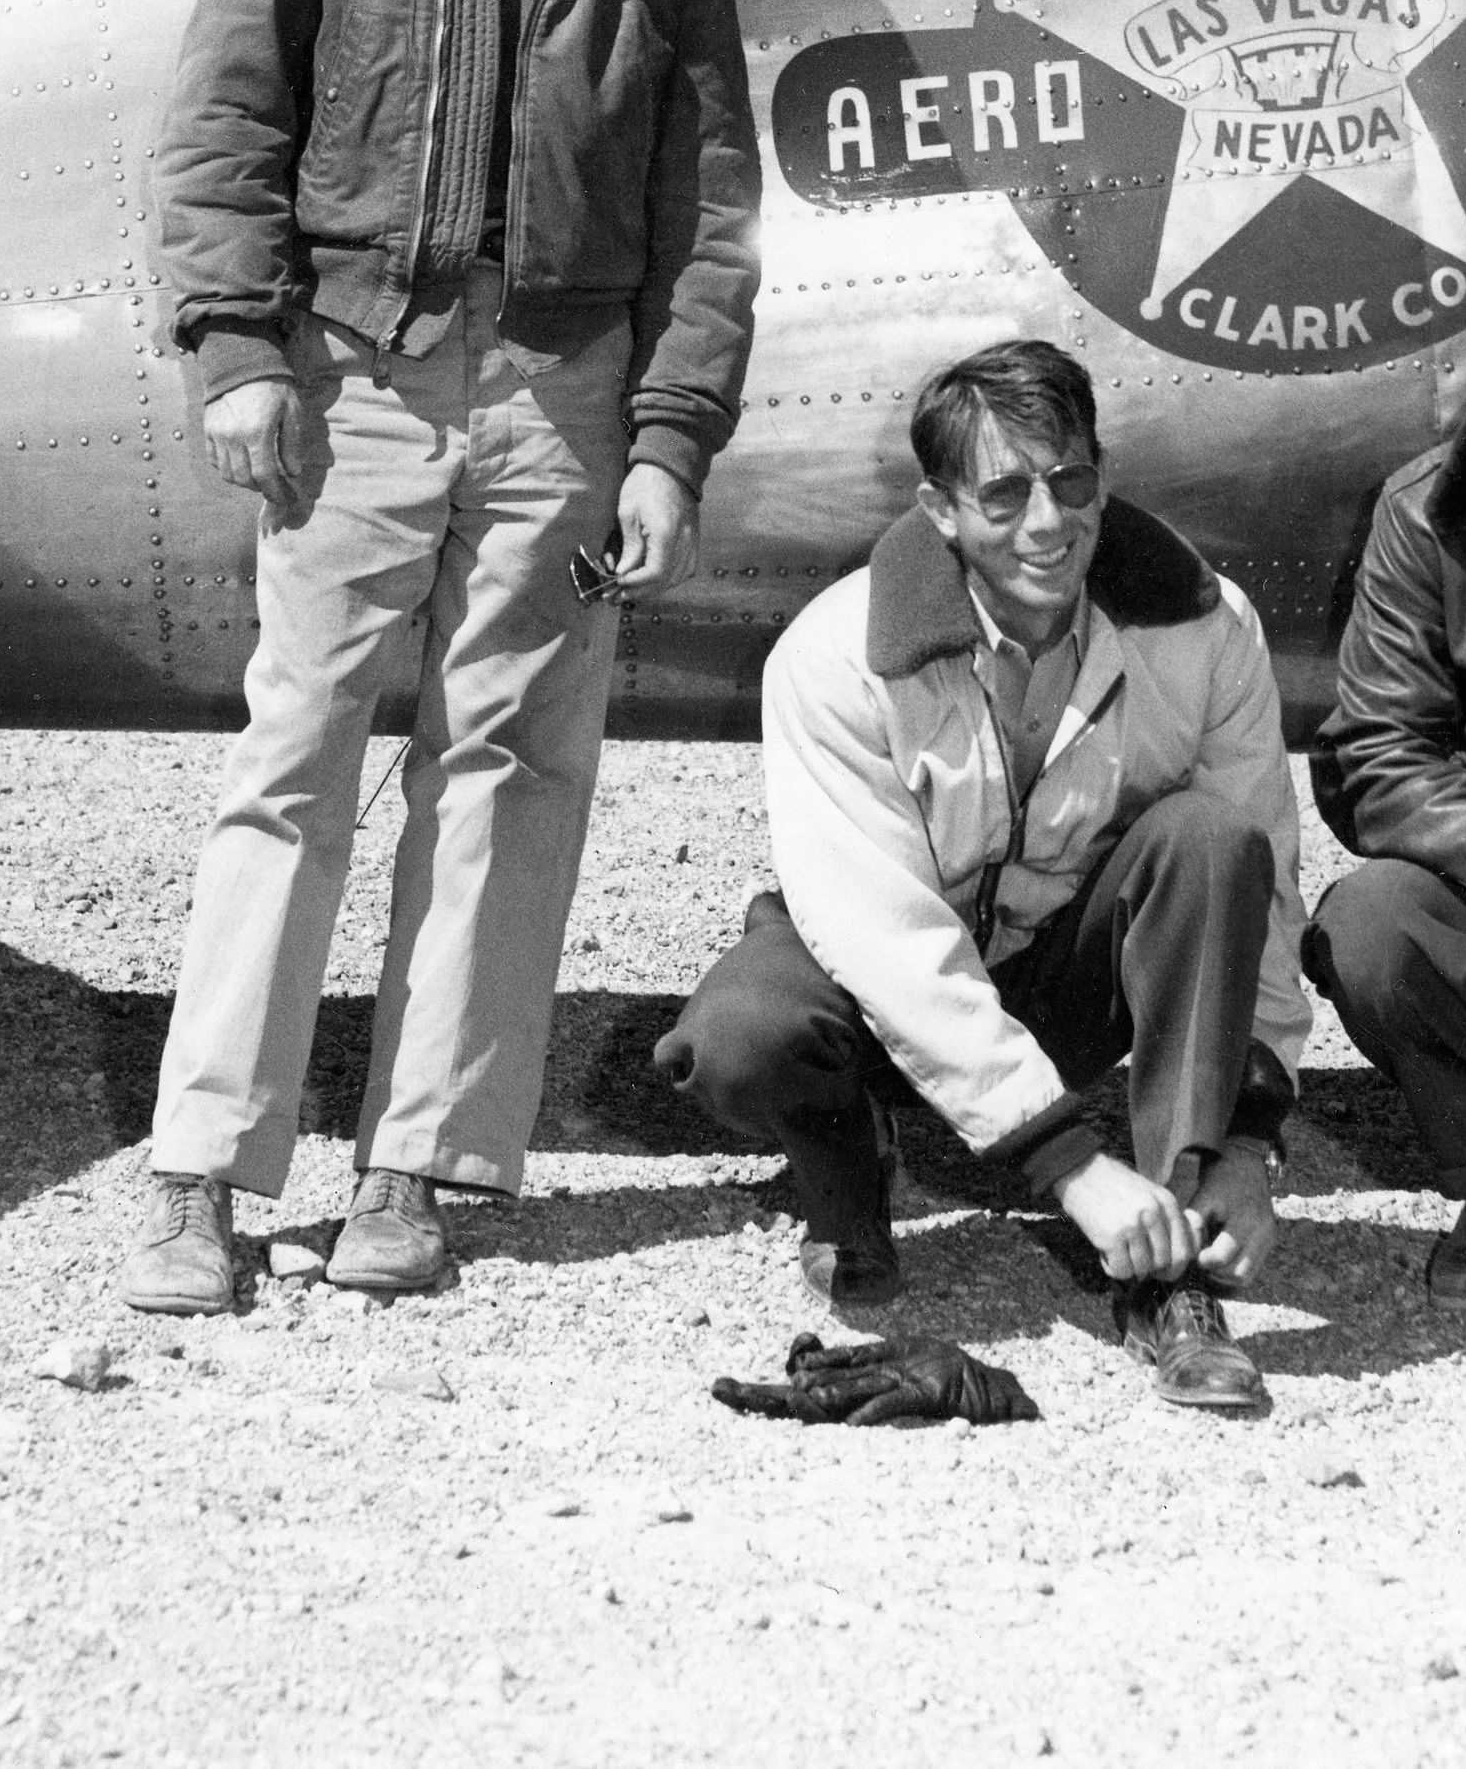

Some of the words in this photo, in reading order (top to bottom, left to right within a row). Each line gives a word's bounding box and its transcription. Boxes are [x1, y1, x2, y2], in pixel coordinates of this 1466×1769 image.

[827, 59, 1085, 173] AERO
[1213, 107, 1401, 164] NEVADA
[1179, 287, 1373, 350] CLARK
